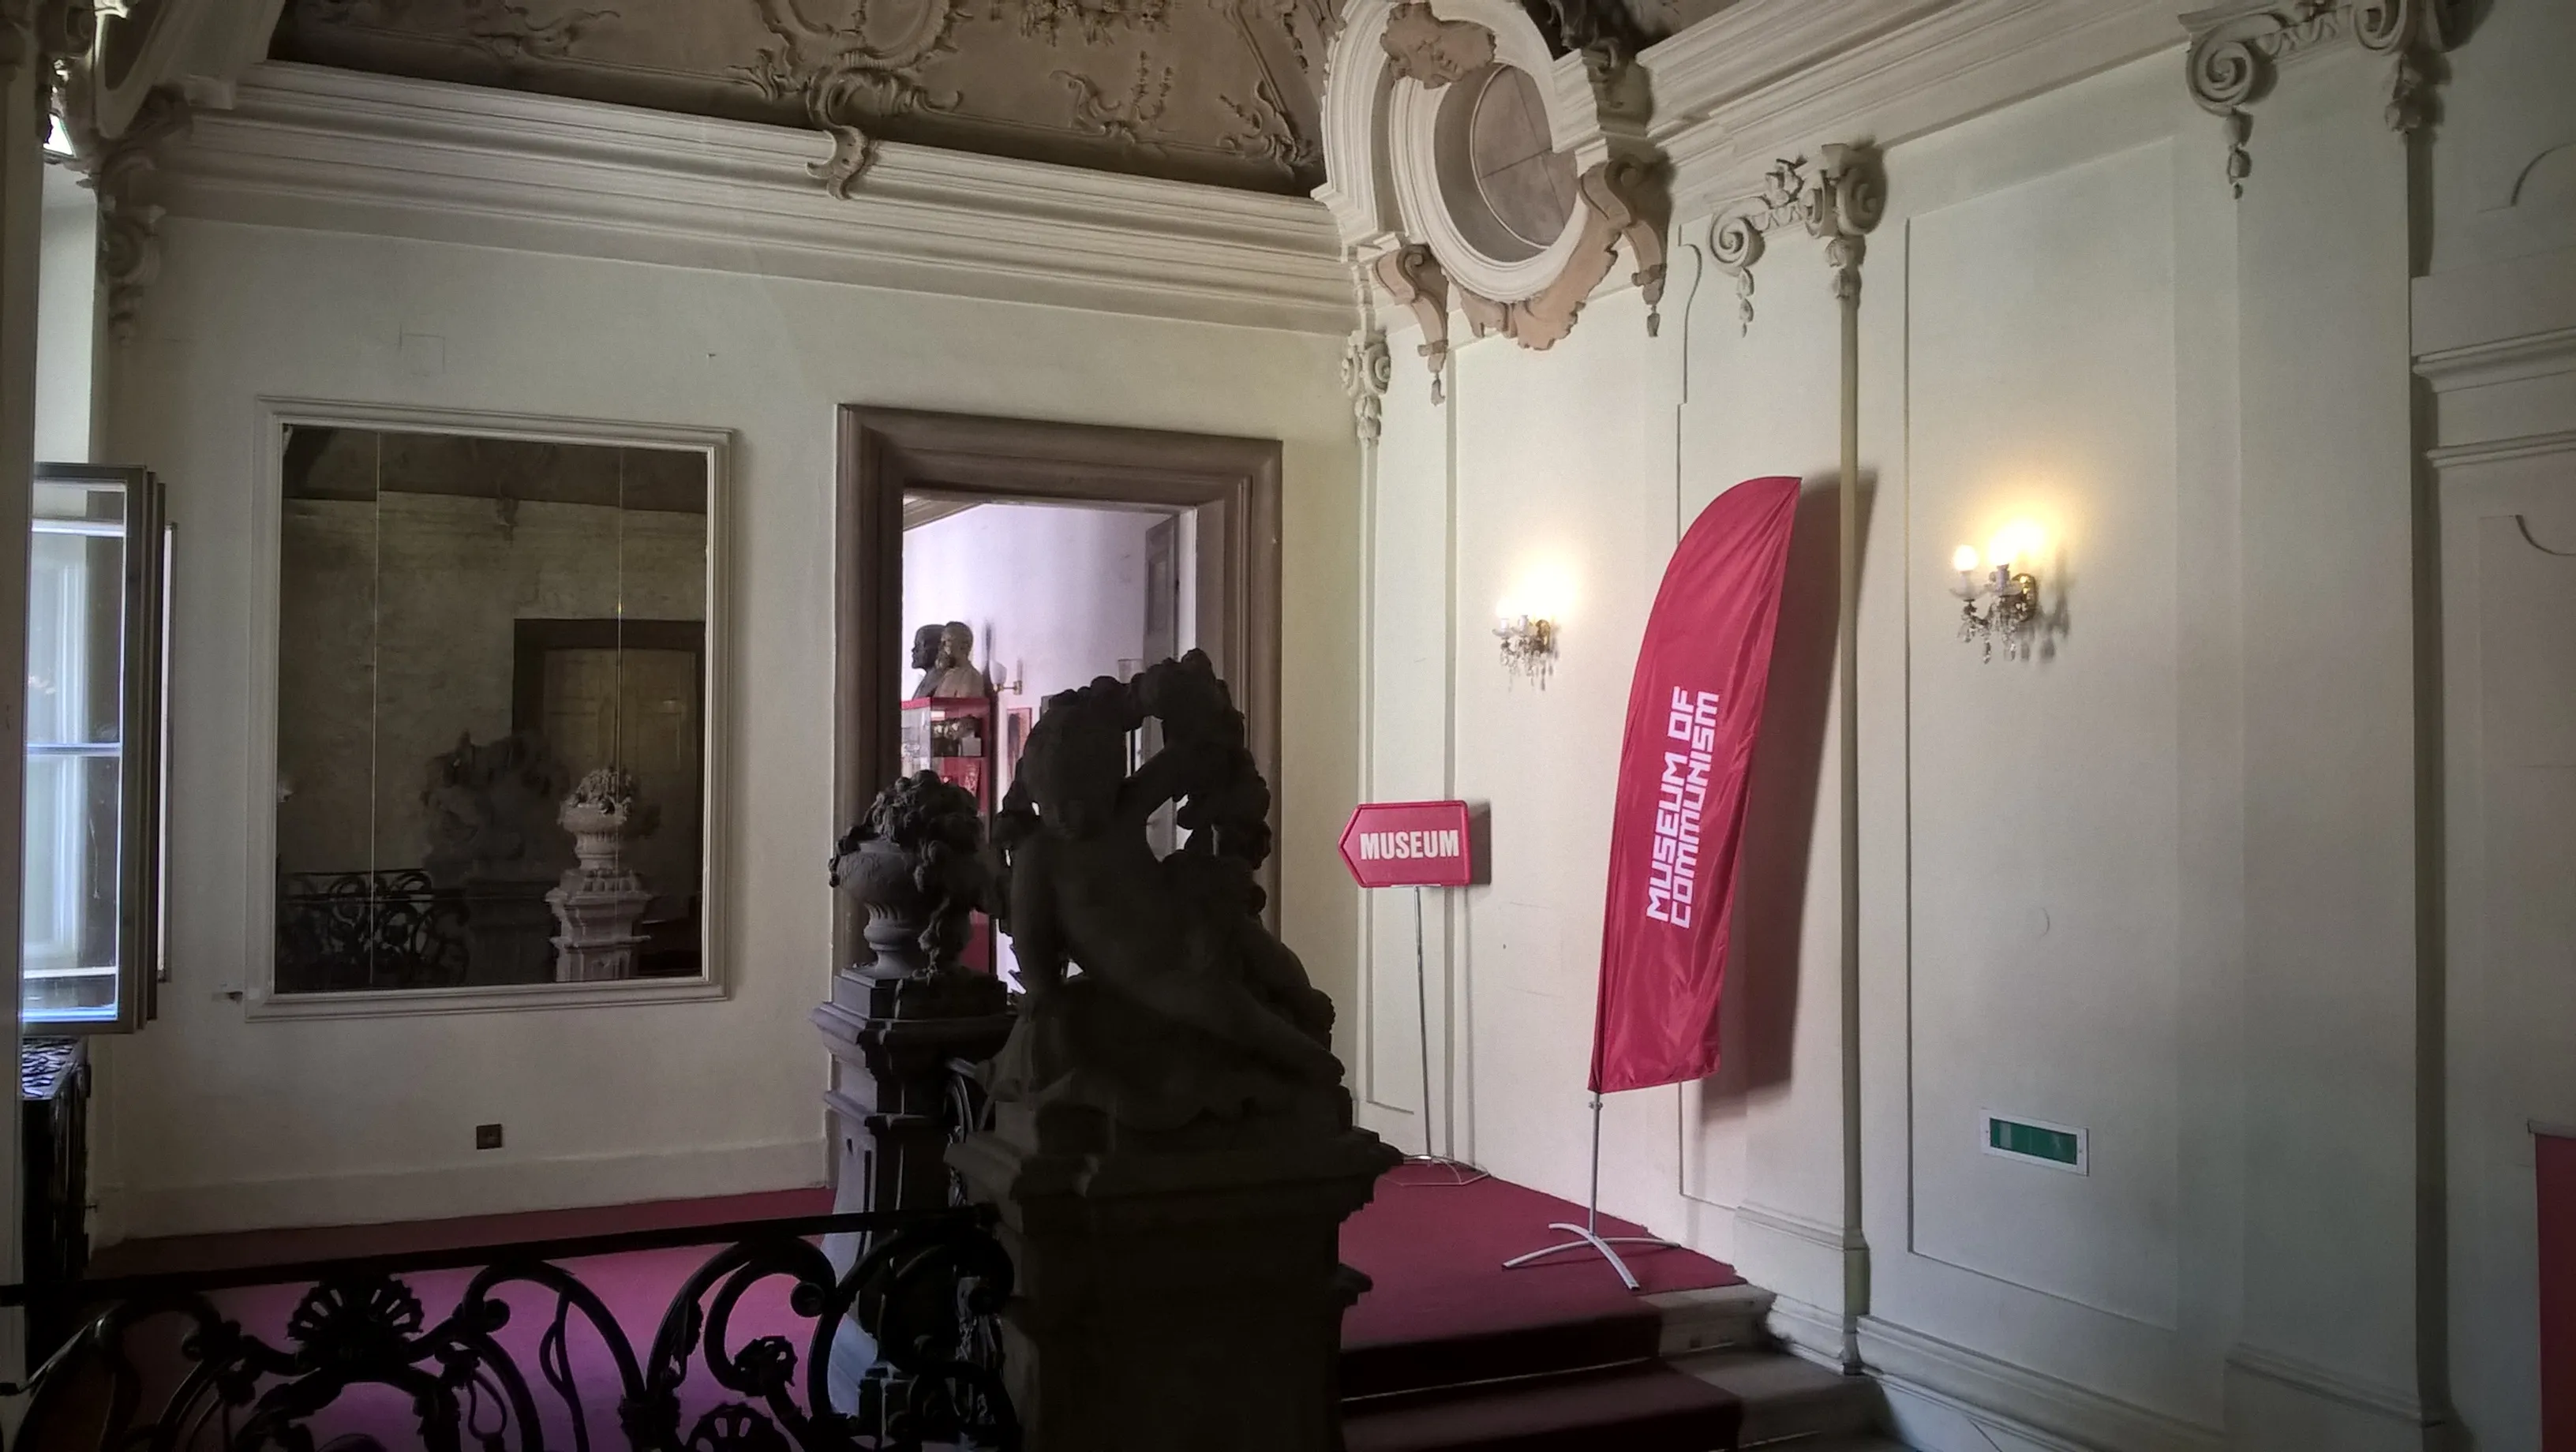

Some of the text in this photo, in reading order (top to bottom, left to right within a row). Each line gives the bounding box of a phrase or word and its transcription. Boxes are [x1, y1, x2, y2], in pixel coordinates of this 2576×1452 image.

[1360, 829, 1459, 859] MUSEUM
[1646, 686, 1694, 922] MUSEUM OF
[1670, 690, 1719, 929] COMMUNISM
